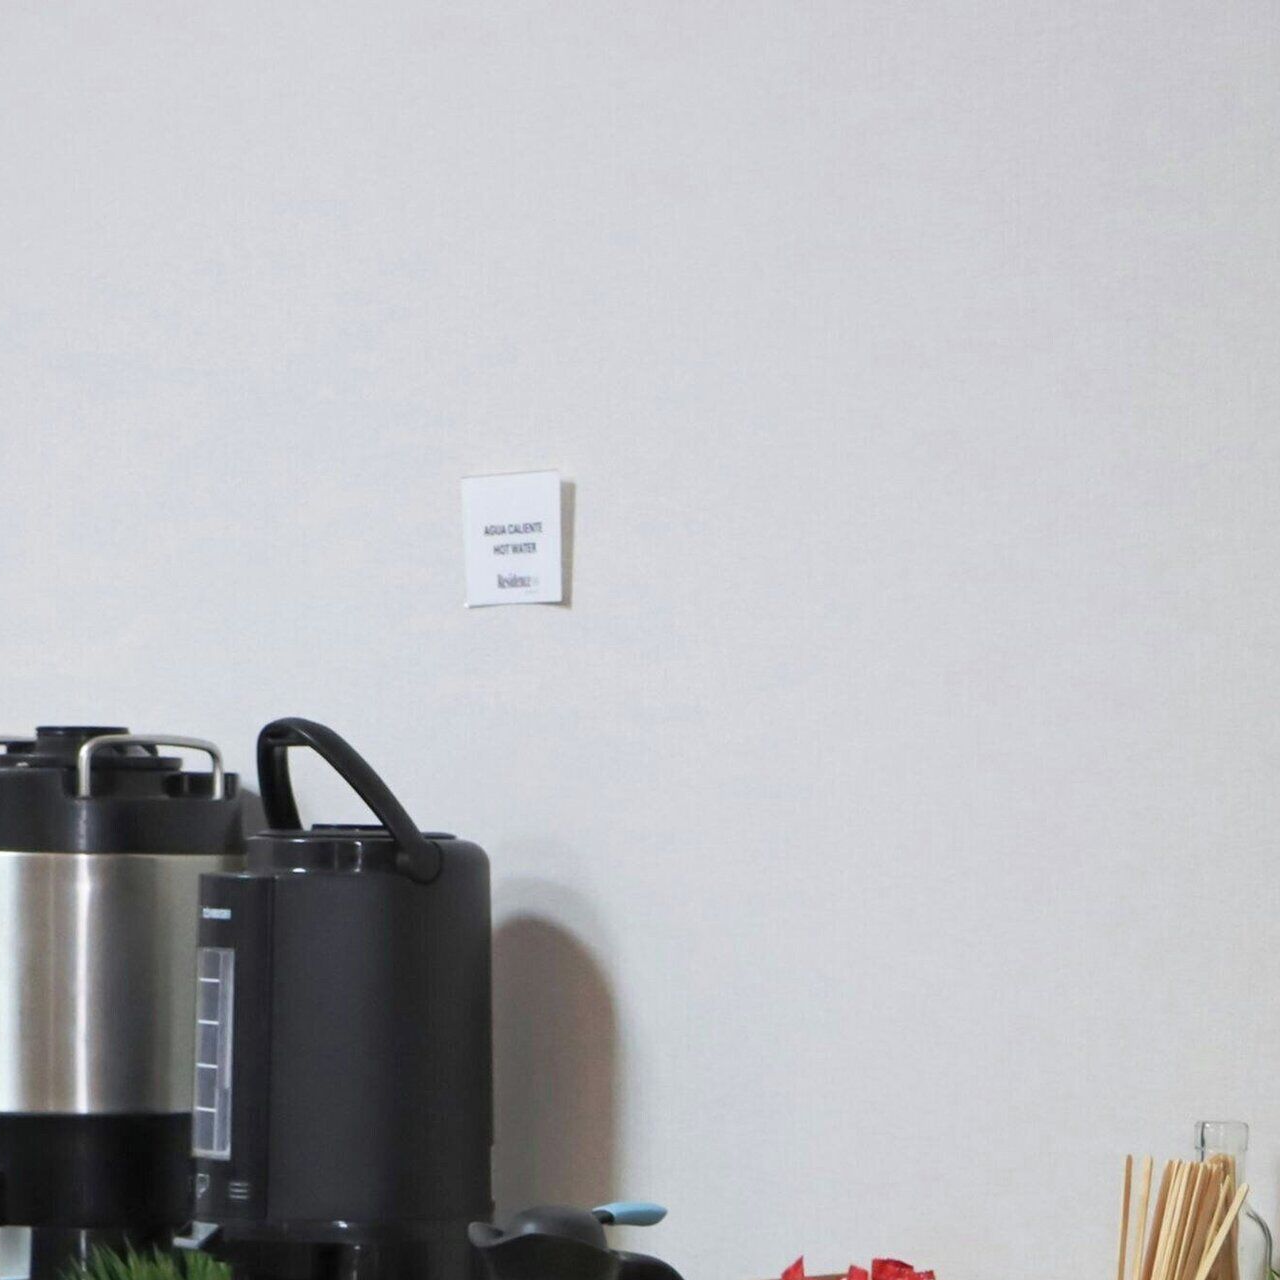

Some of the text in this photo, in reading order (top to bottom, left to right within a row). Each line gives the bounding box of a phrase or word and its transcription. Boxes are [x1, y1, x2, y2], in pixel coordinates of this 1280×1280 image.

[484, 522, 543, 536] AGUA CALIENTE
[493, 542, 537, 555] HOT WATER
